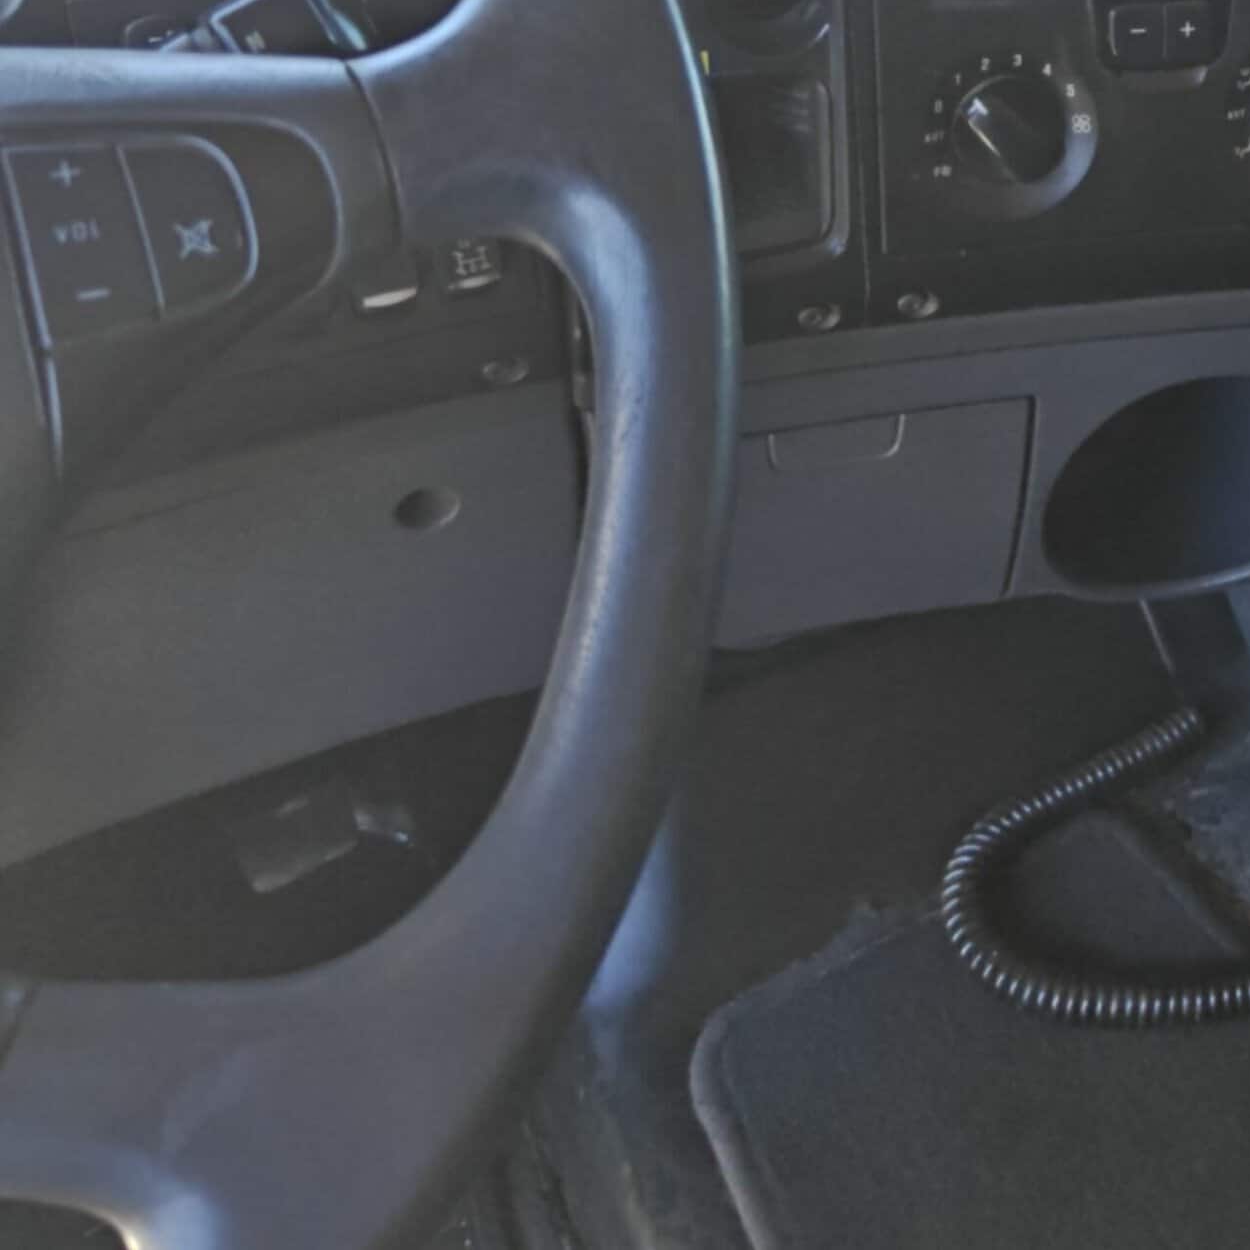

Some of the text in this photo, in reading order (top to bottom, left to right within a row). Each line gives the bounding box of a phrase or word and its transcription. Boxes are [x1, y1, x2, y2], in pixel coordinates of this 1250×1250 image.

[980, 56, 991, 71] 2
[1012, 53, 1023, 67] 3
[1041, 62, 1053, 77] 4
[1066, 82, 1076, 98] 5
